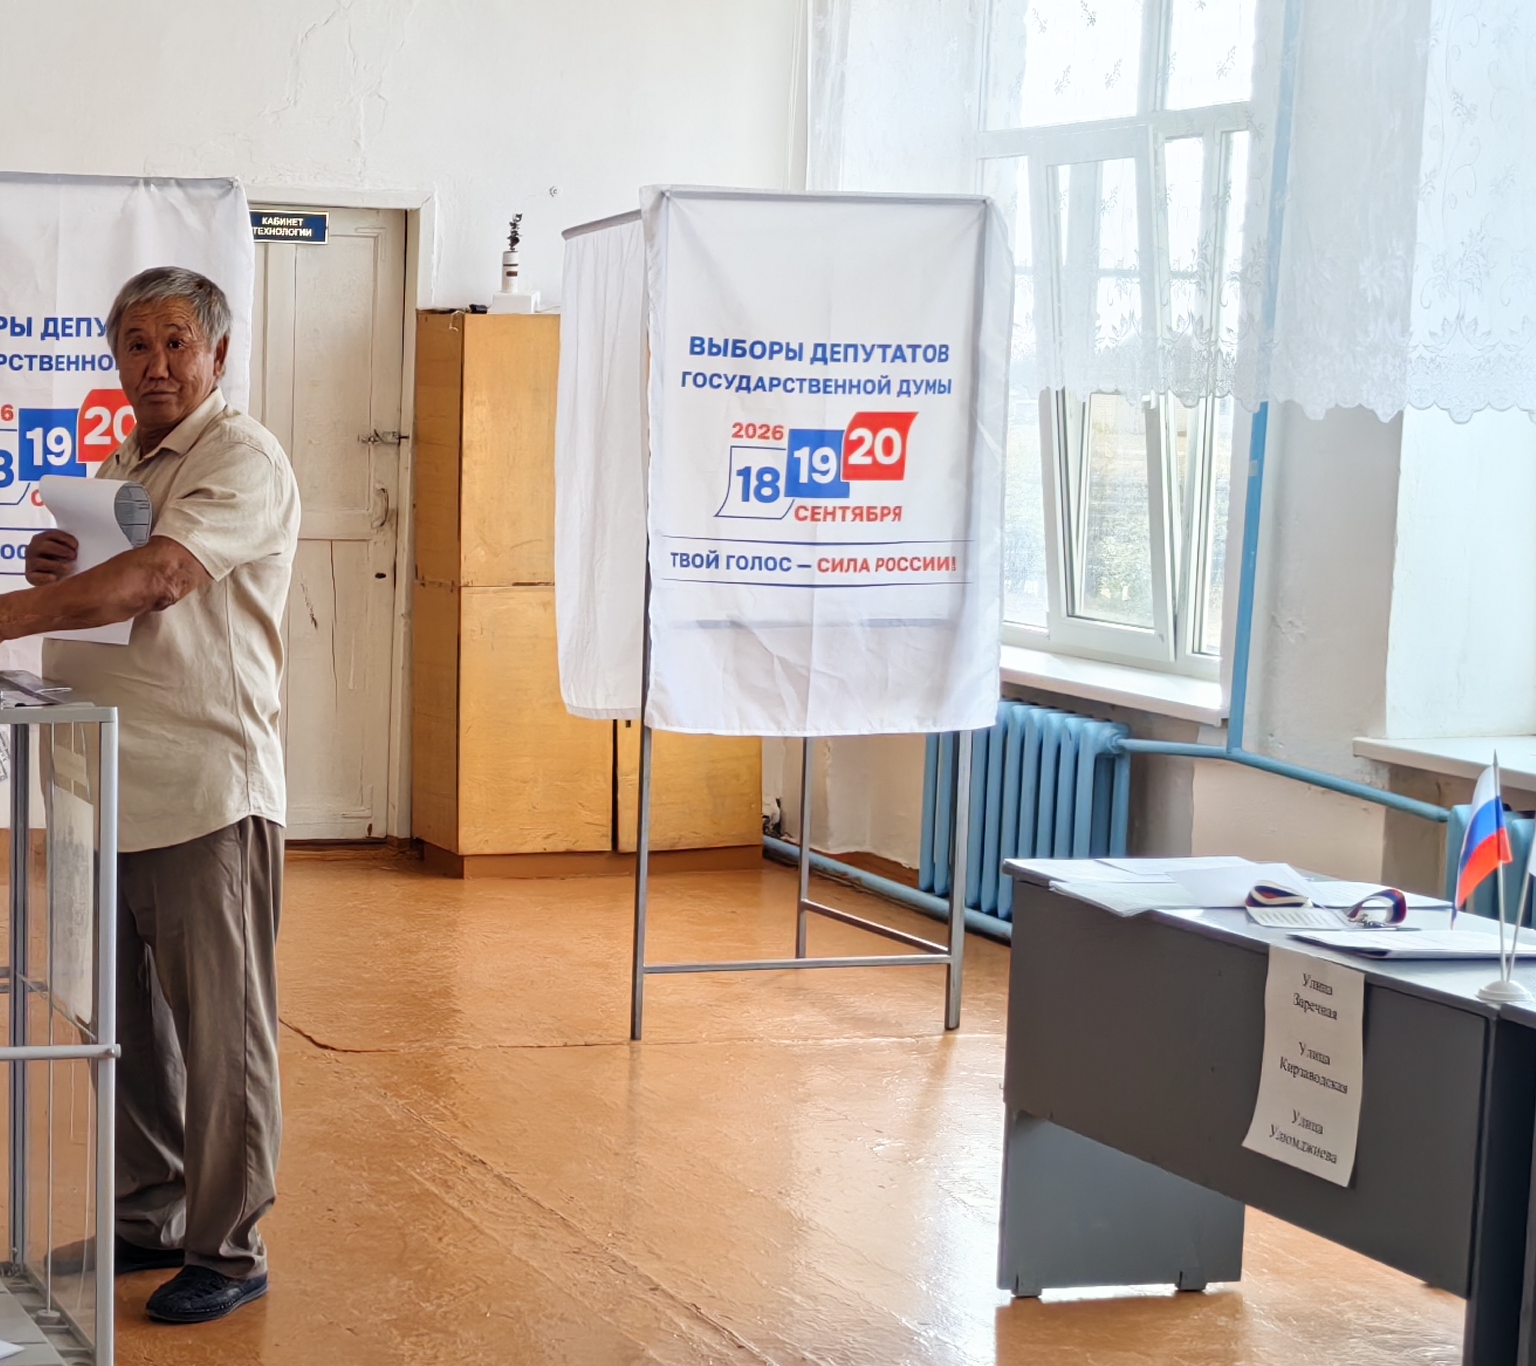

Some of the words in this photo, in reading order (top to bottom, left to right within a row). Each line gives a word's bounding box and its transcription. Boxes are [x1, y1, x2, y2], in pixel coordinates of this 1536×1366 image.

[253, 226, 313, 237] ТЕХНОЛОГИИ
[261, 216, 304, 227] КАБИНЕТ
[689, 335, 804, 362] ВЫБОРЫ
[809, 342, 950, 366] ДЕПУТАТОВ
[681, 371, 892, 396] ГОСУДАРСТВЕННОЙ
[897, 378, 953, 398] ДУМЫ
[731, 421, 785, 441] 2026
[25, 426, 73, 467] 19
[735, 465, 781, 504] 18
[792, 446, 838, 484] 19
[847, 427, 902, 466] 20
[793, 504, 903, 524] СЕНТЯБРЯ
[670, 550, 720, 570] ТВОЙ
[725, 554, 792, 573] ГОЛОС
[817, 557, 871, 574] СИЛА
[875, 555, 957, 573] РОССИИ!
[1302, 972, 1333, 996] Улица
[1292, 992, 1338, 1020] Заречная
[1298, 1041, 1331, 1066] Улица
[1291, 1109, 1324, 1135] Улица
